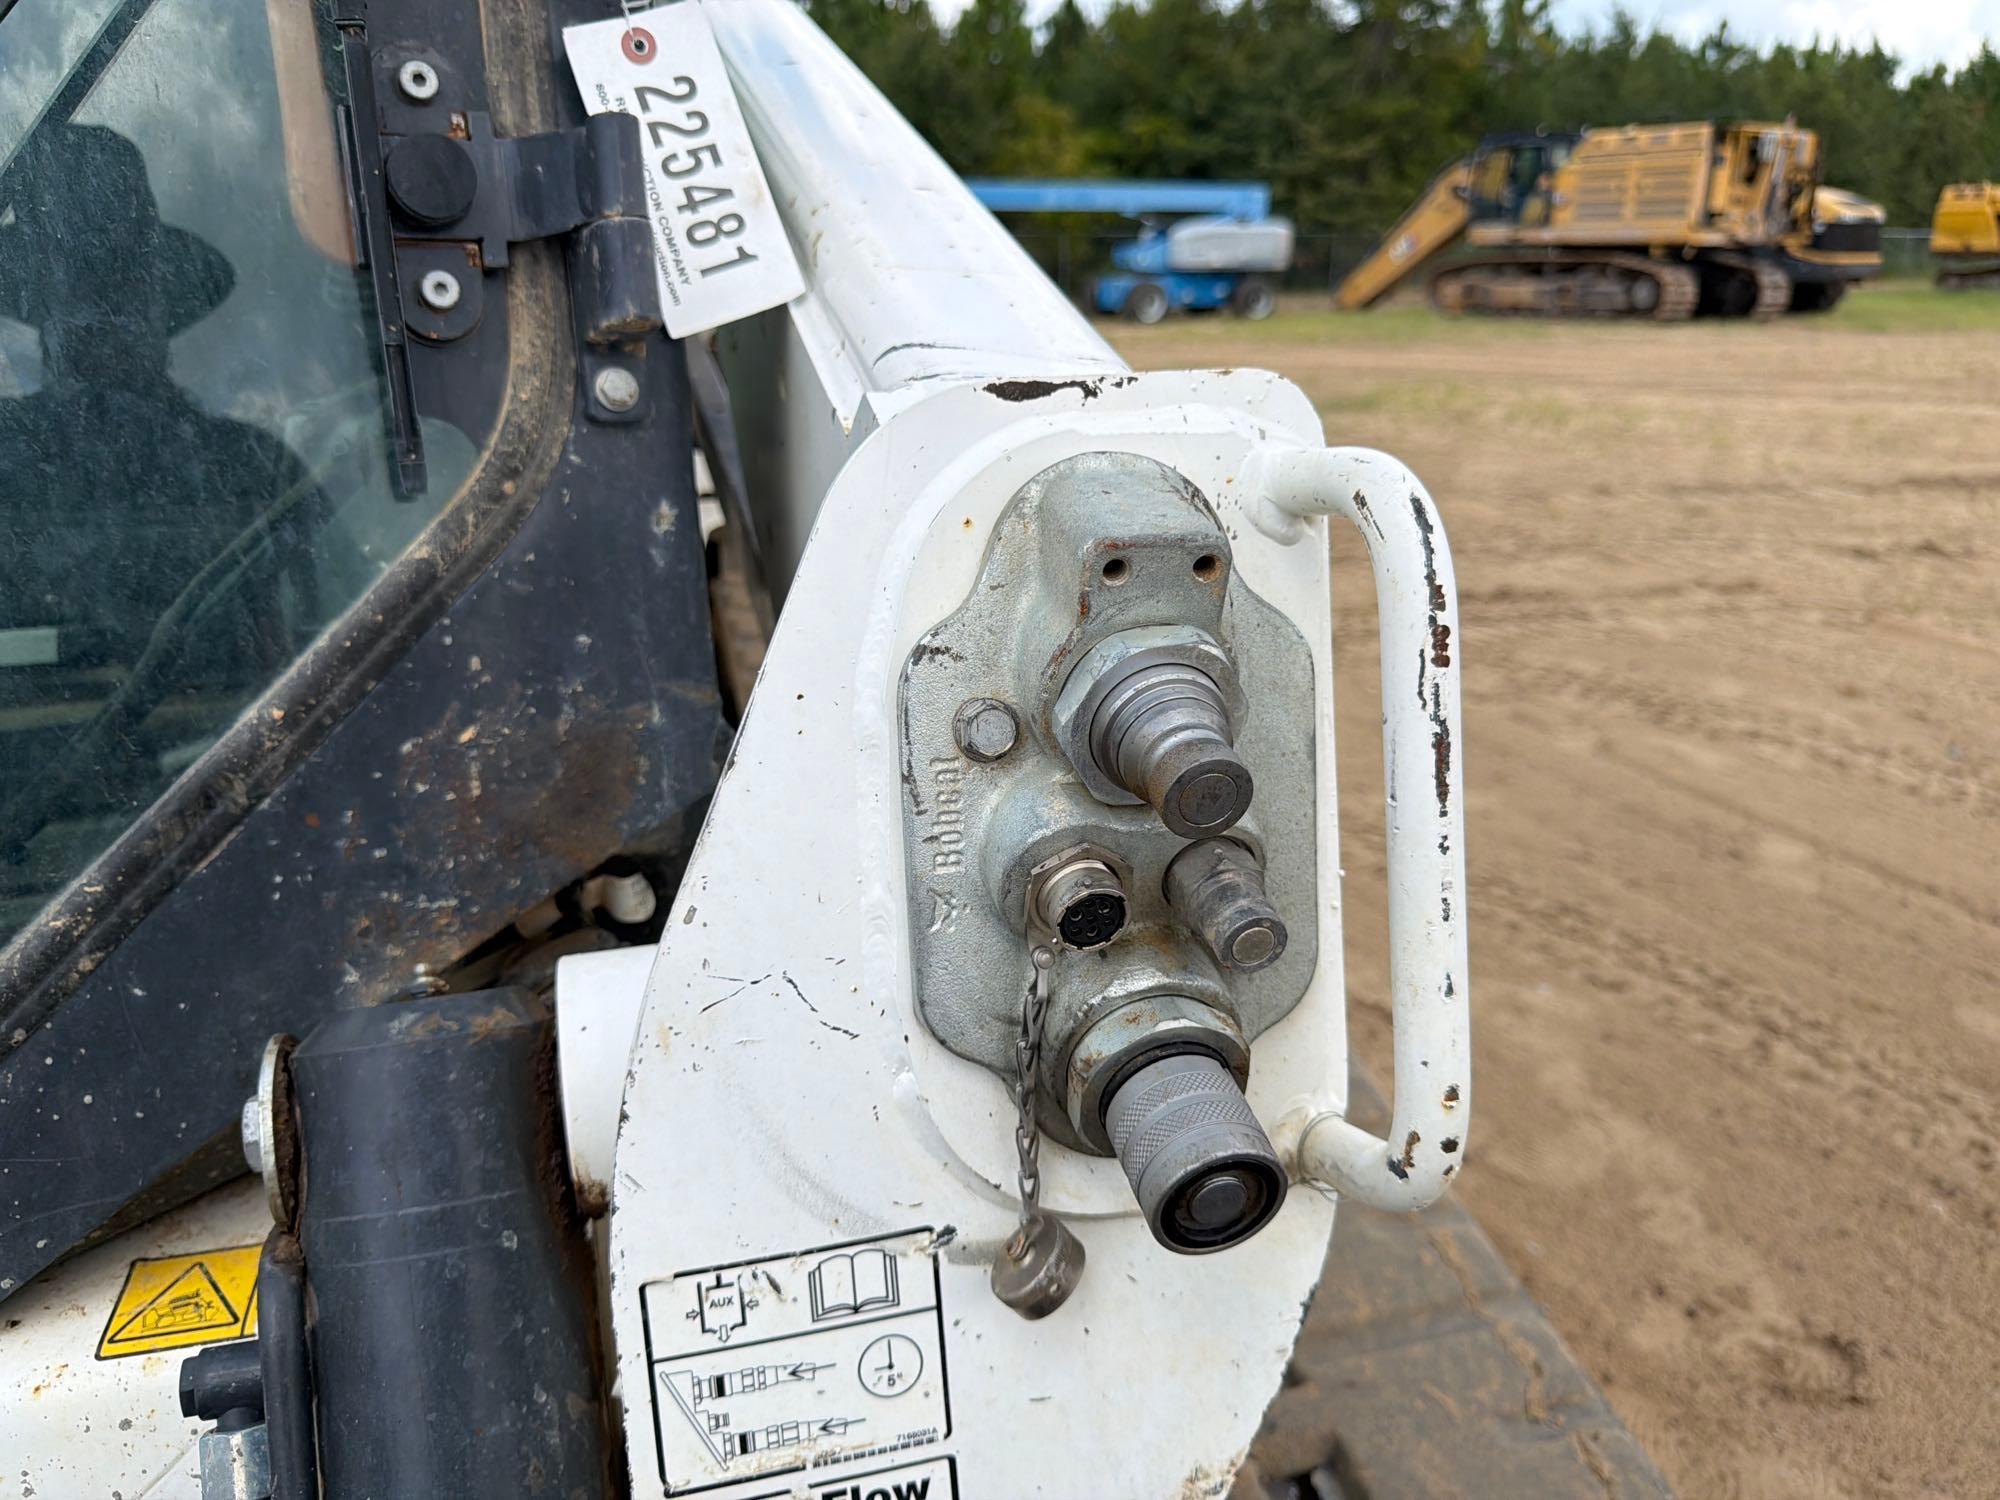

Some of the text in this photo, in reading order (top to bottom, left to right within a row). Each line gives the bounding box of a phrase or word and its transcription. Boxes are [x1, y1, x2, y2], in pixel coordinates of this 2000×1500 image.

[634, 76, 759, 279] 225481
[658, 215, 692, 286] COMPANY
[929, 756, 967, 875] Bobcat
[709, 1295, 735, 1309] AUX
